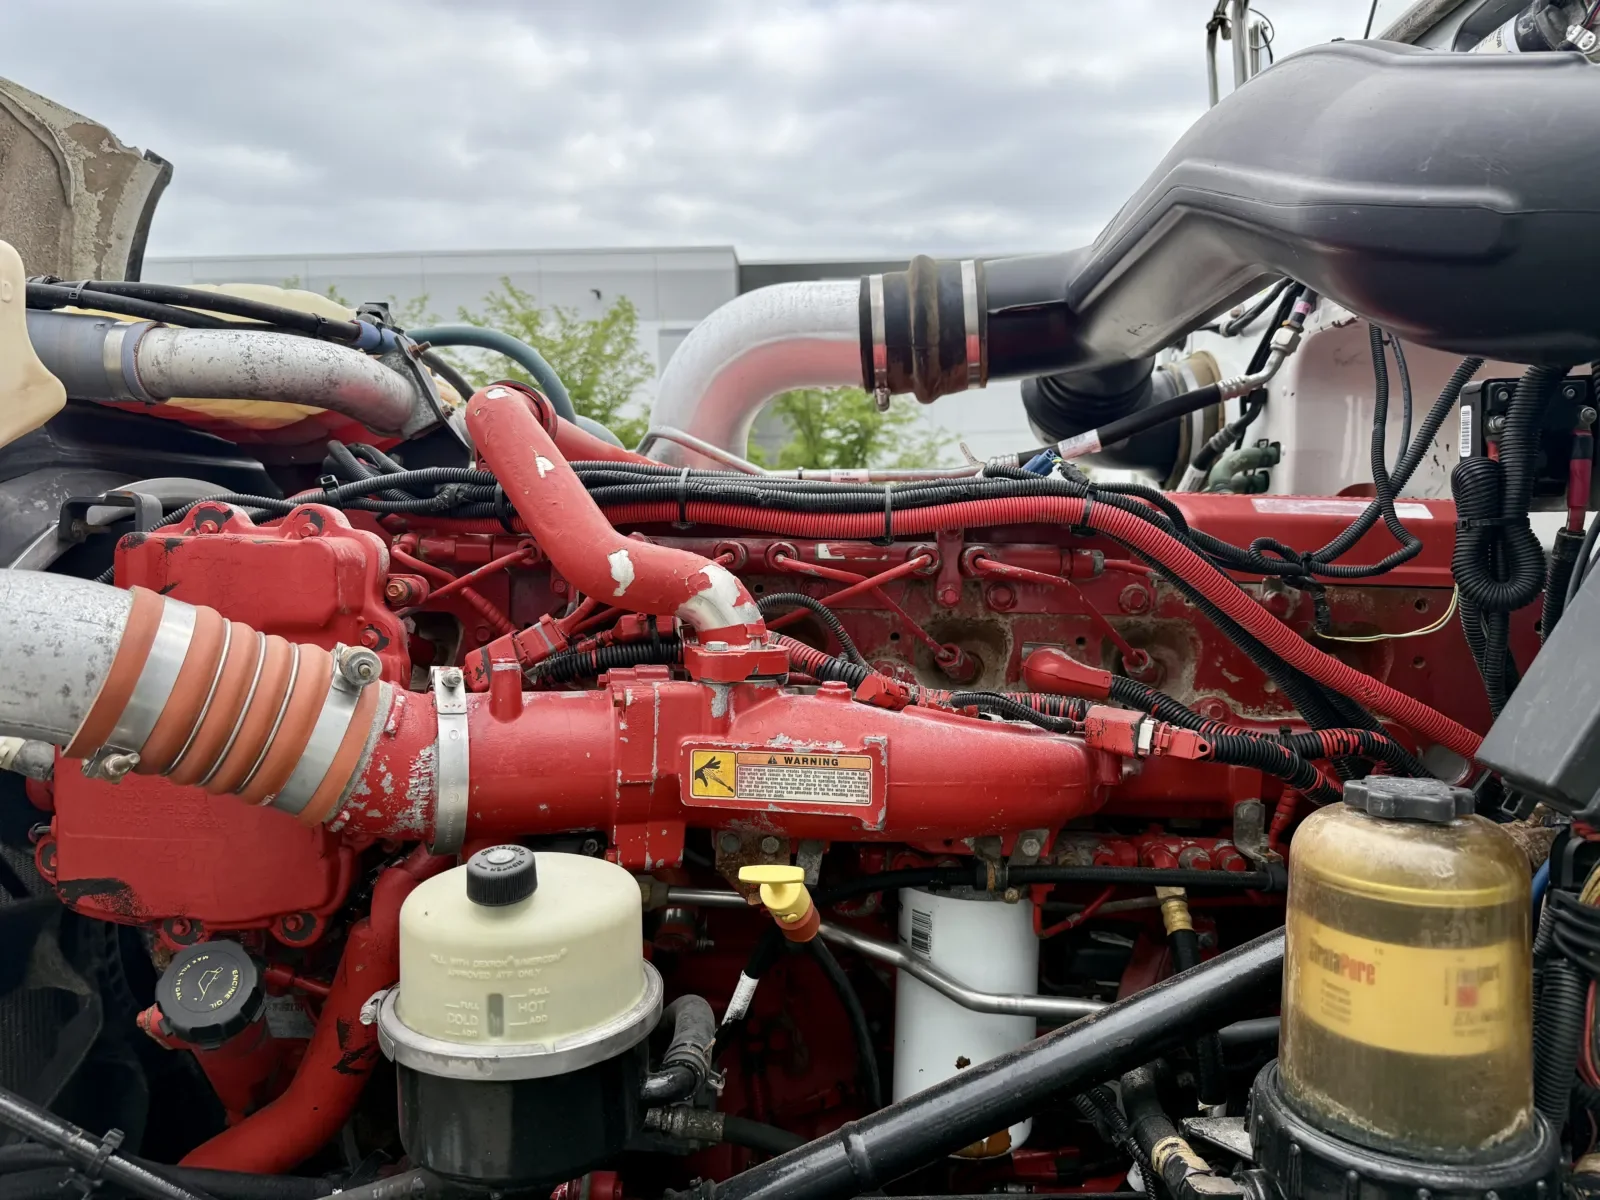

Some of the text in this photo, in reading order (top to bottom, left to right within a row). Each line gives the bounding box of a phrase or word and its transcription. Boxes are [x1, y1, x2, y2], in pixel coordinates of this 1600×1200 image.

[784, 756, 838, 766] WARNING
[179, 964, 190, 976] FILL
[448, 968, 491, 979] APPROVED
[518, 968, 542, 980] ONLY
[210, 970, 238, 1008] ENGINE OIL
[528, 986, 550, 996] FULL
[460, 1001, 479, 1010] FULL
[518, 1000, 546, 1013] HOT
[447, 1012, 479, 1025] COLD
[530, 1014, 548, 1024] ADD
[462, 1028, 478, 1037] ADD
